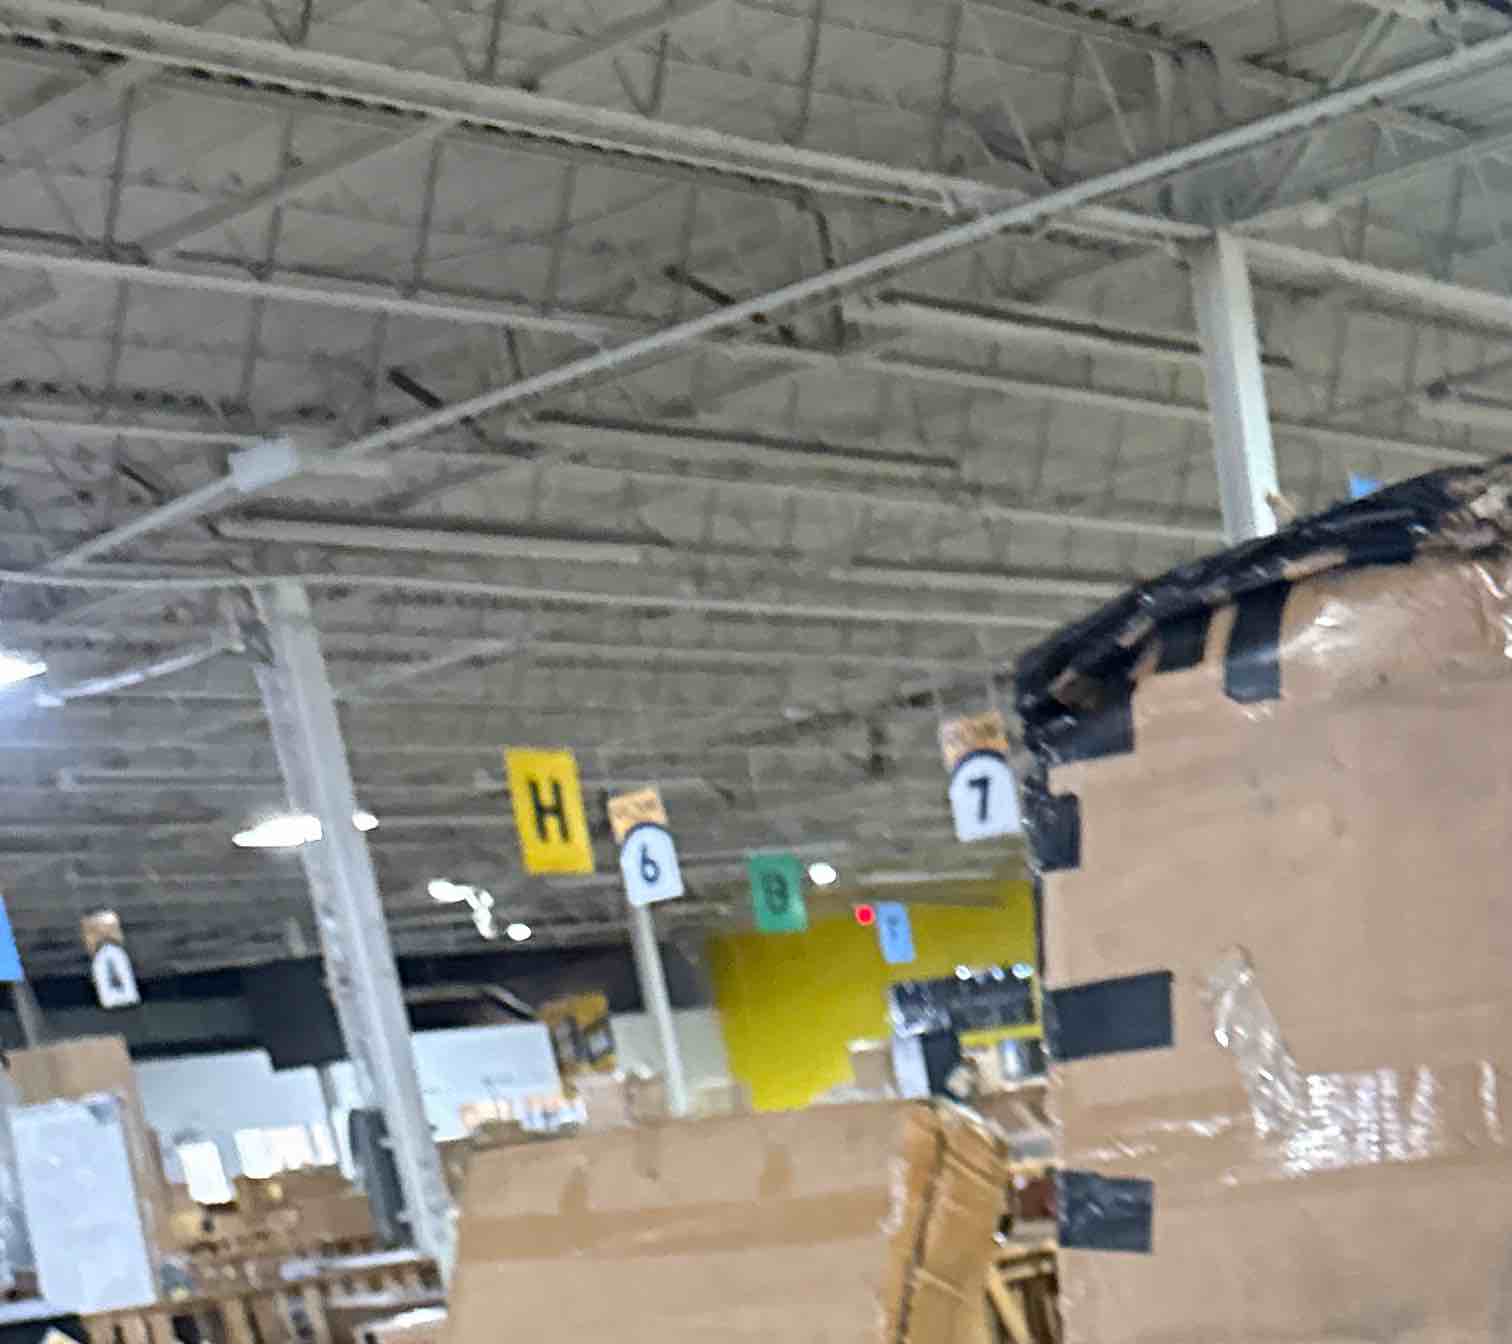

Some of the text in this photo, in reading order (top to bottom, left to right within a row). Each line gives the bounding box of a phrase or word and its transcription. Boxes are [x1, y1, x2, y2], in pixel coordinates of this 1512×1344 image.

[526, 776, 572, 844] H
[967, 775, 991, 822] 7
[638, 842, 661, 885] 6
